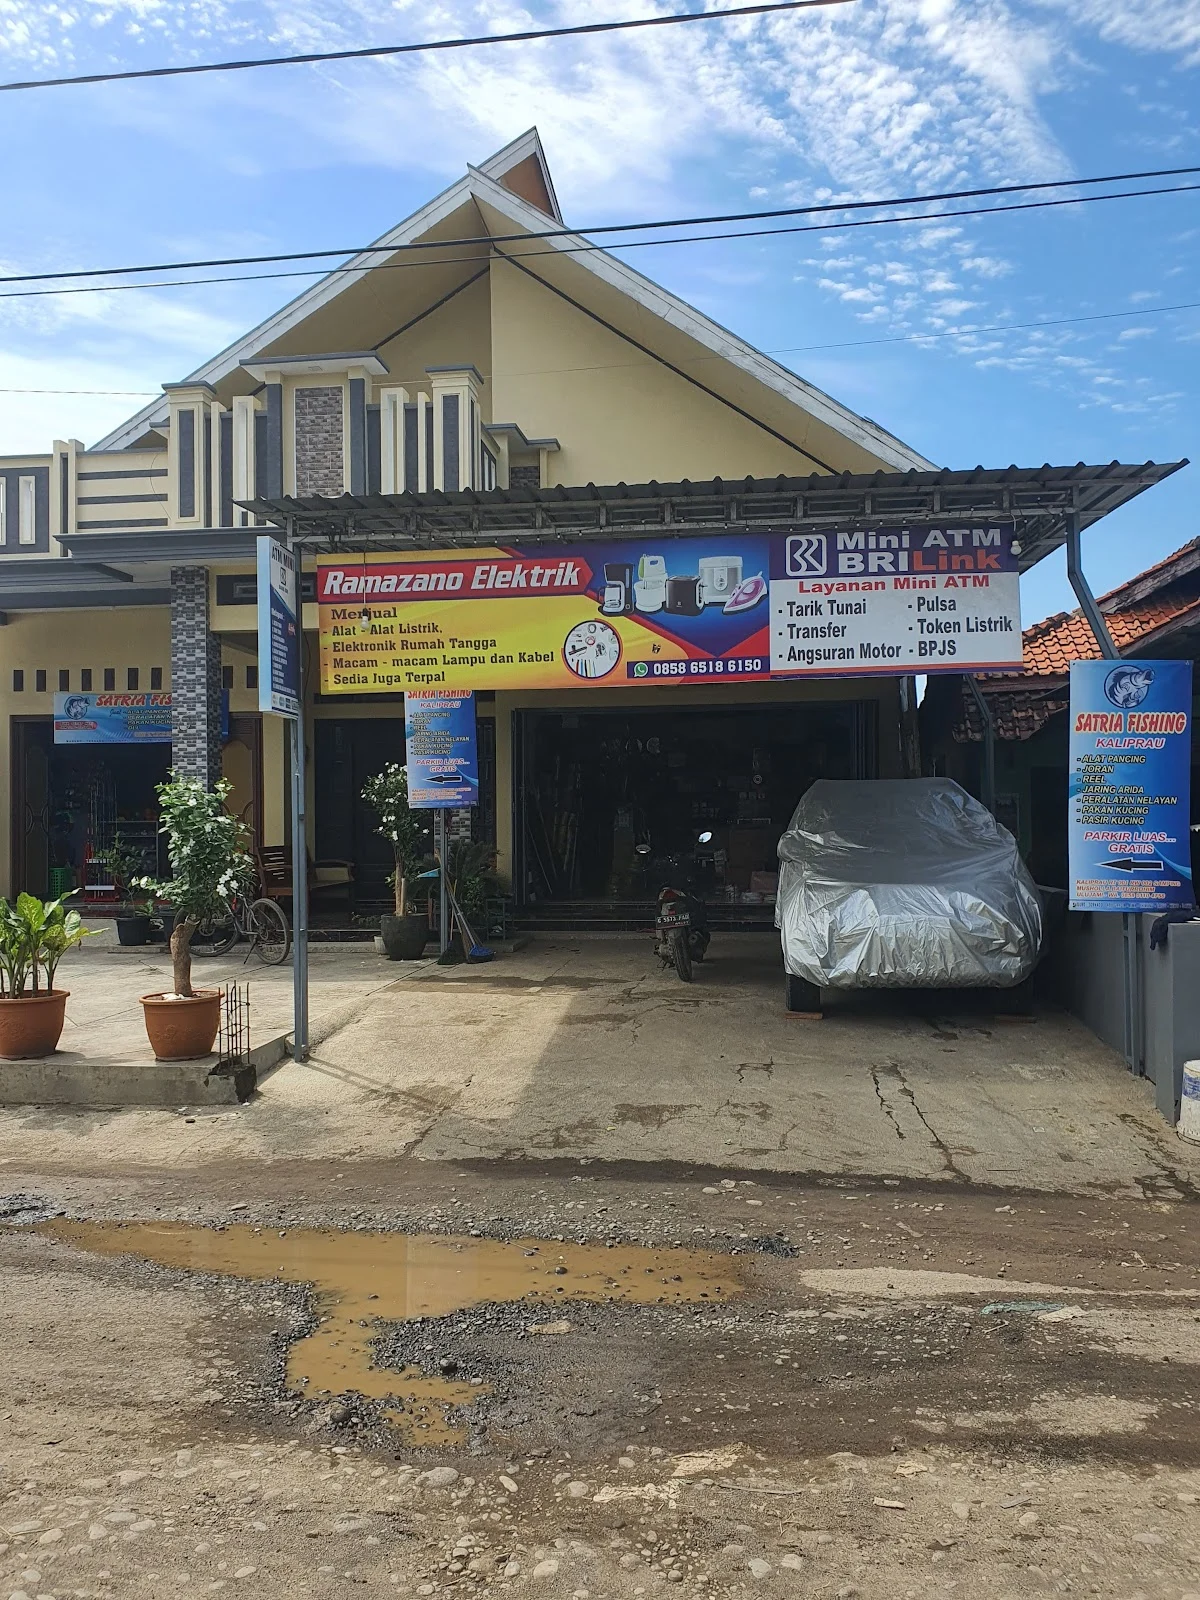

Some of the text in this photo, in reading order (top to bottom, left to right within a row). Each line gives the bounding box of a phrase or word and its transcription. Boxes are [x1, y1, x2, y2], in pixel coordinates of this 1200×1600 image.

[836, 528, 1001, 550] Mini ATM
[838, 549, 1002, 574] BRILink
[323, 561, 582, 595] Ramazano Elektrik
[798, 575, 990, 596] Layanan Mini ATM
[787, 599, 867, 617] Tarik Tunai
[917, 596, 957, 612] Pulsa
[332, 622, 443, 637] Alat Alat Listrik.
[787, 622, 848, 640] Transfer
[917, 616, 1013, 635] Token Listrik
[333, 638, 497, 653] Elektronik Rumah Tangga
[918, 640, 957, 657] BPJS
[333, 651, 555, 668] Macam macam Lampu dan Kabel
[787, 643, 902, 664] Angsuran Motor
[653, 659, 762, 675] 0858 6518 6150
[333, 671, 446, 686] Sedia Juga Terpal
[96, 695, 147, 707] SATRIA
[1075, 713, 1187, 733] SATRIA FISHING
[1096, 738, 1165, 748] KALIPRAU
[1081, 754, 1146, 764] ALAT PANCING
[1082, 765, 1114, 773] JORAN
[1082, 775, 1106, 784] REEL
[1082, 785, 1116, 794] JARING
[1082, 795, 1178, 805] PERALATAN NELAYAN
[1082, 805, 1149, 815] PAKAN KUCING
[1082, 816, 1145, 825] PASIR KUCING
[1084, 831, 1131, 841] PARKIR
[1109, 843, 1154, 853] GRATIS
